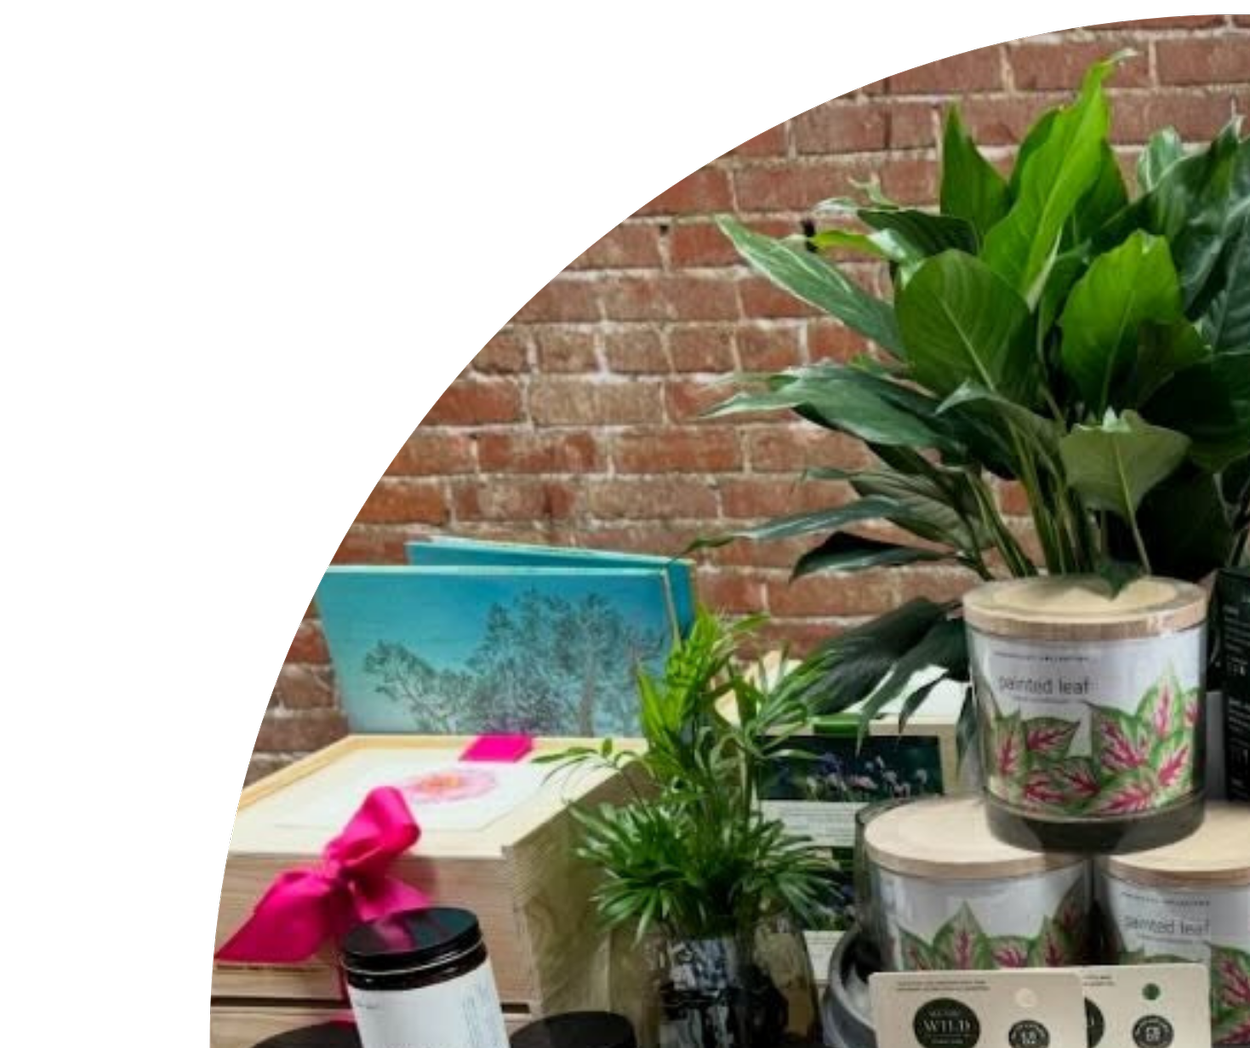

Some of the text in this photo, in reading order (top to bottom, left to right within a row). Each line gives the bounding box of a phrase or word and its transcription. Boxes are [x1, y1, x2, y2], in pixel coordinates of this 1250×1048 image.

[1000, 676, 1091, 696] painted leaf
[1122, 917, 1211, 936] painted leaf
[922, 1018, 972, 1033] WILD
